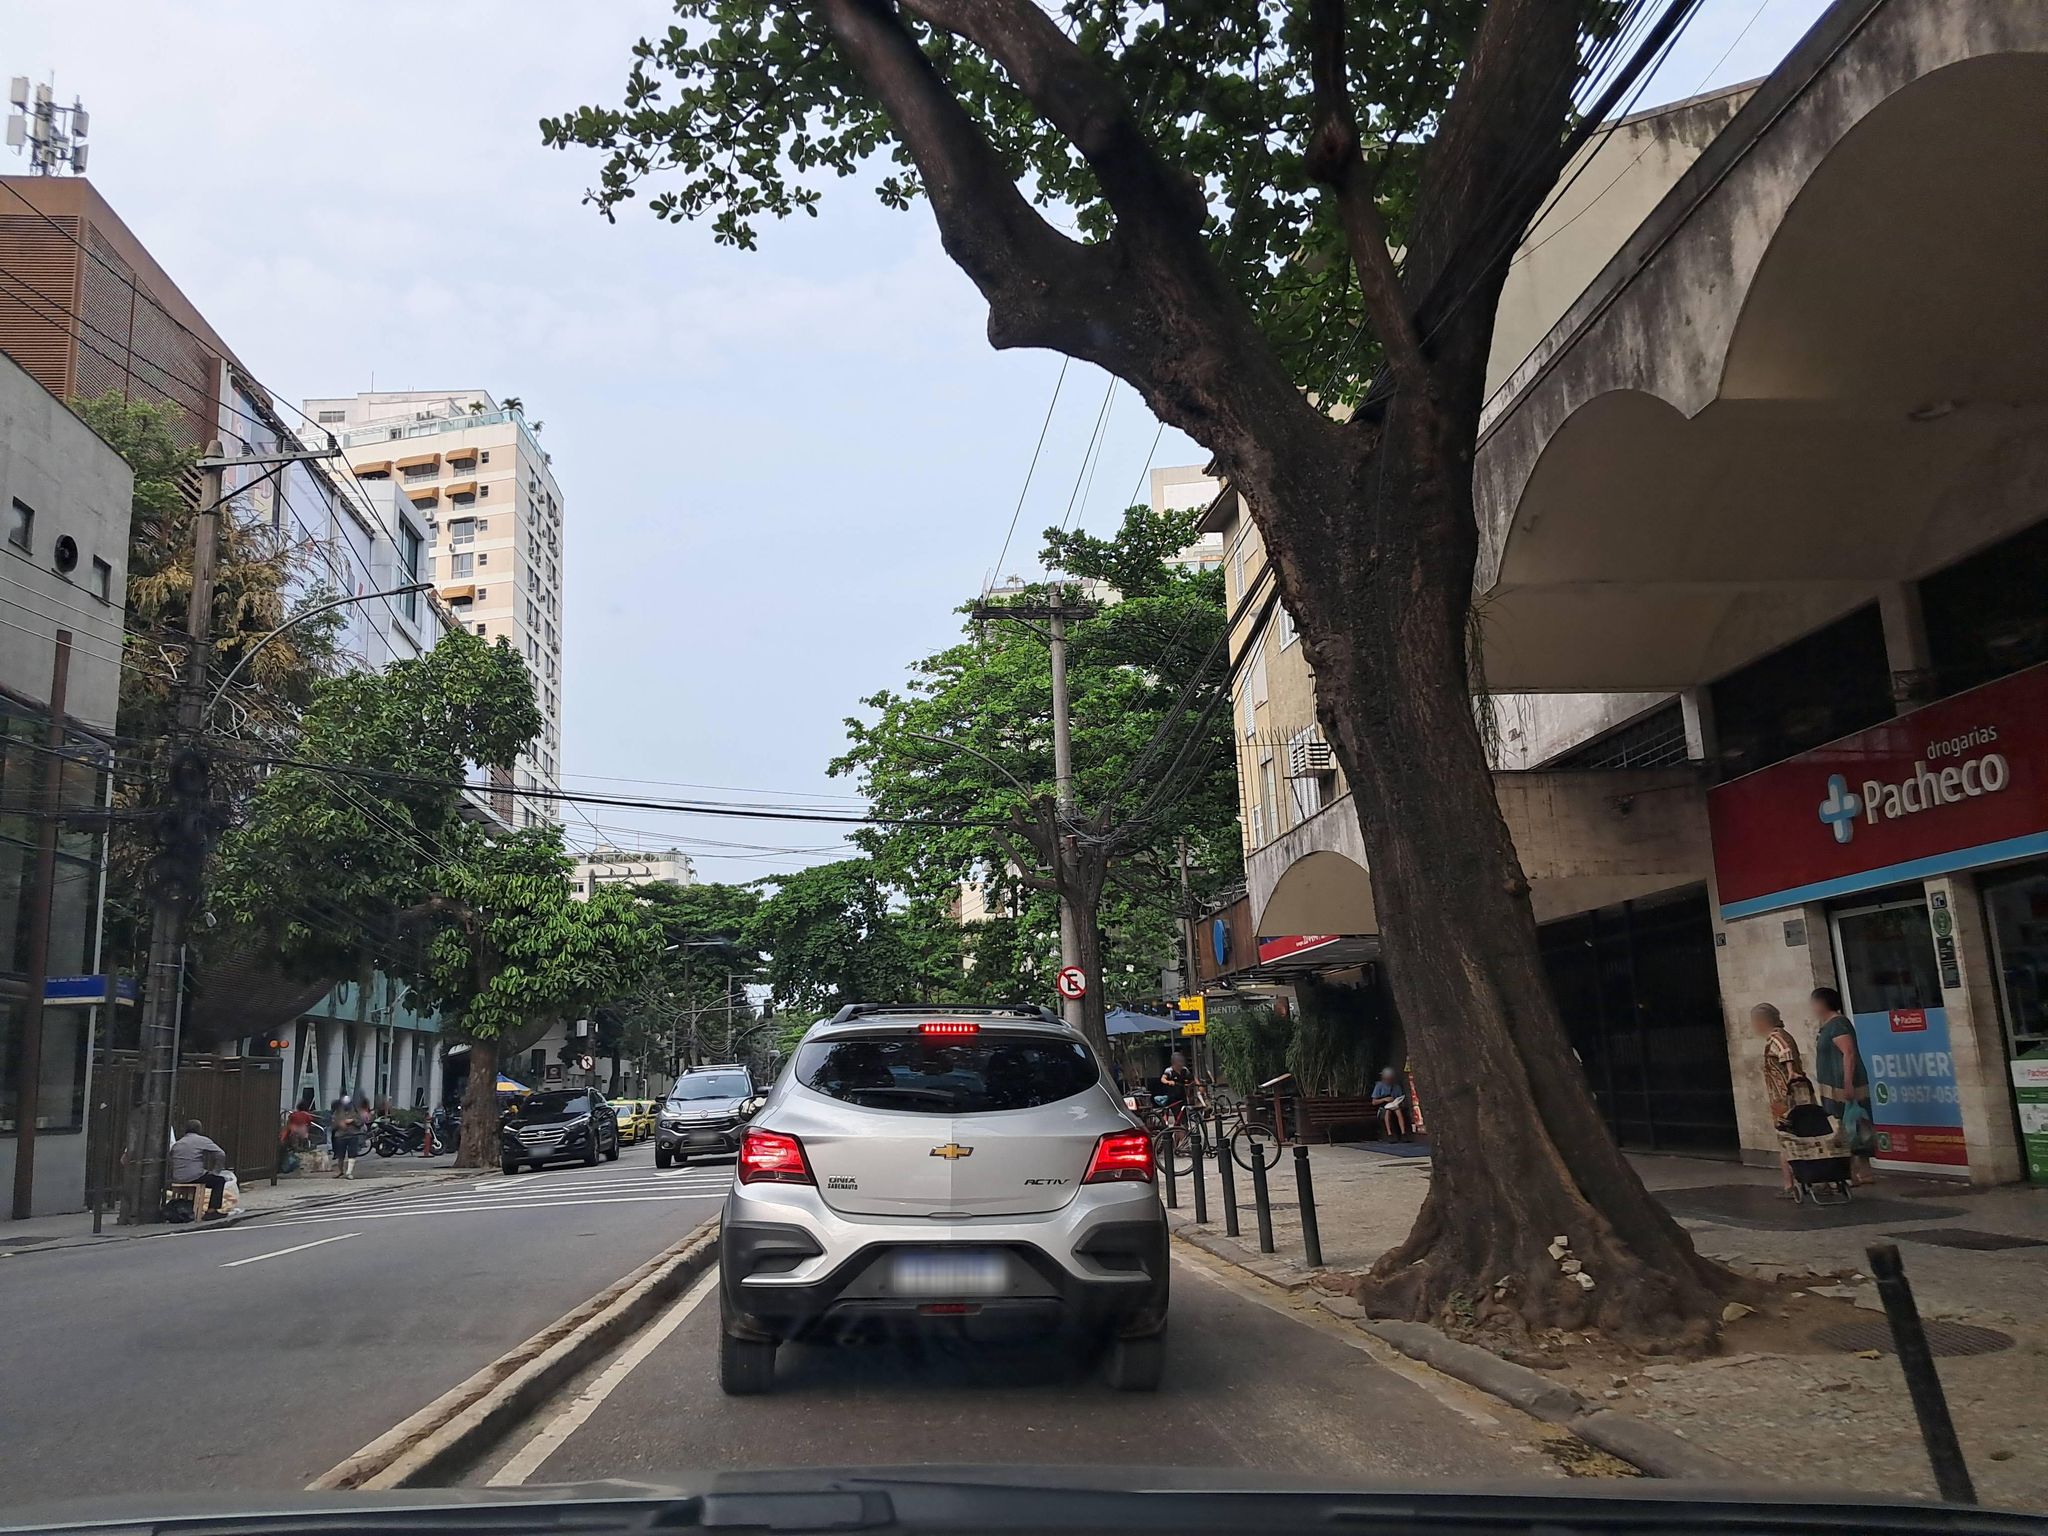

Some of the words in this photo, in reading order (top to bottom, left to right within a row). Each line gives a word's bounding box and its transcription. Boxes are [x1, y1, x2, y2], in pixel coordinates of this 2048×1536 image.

[1927, 726, 1998, 759] drogarias
[1863, 753, 2008, 824] Pacheco
[1872, 1052, 1953, 1078] DELIVER
[829, 1175, 856, 1183] ONIX
